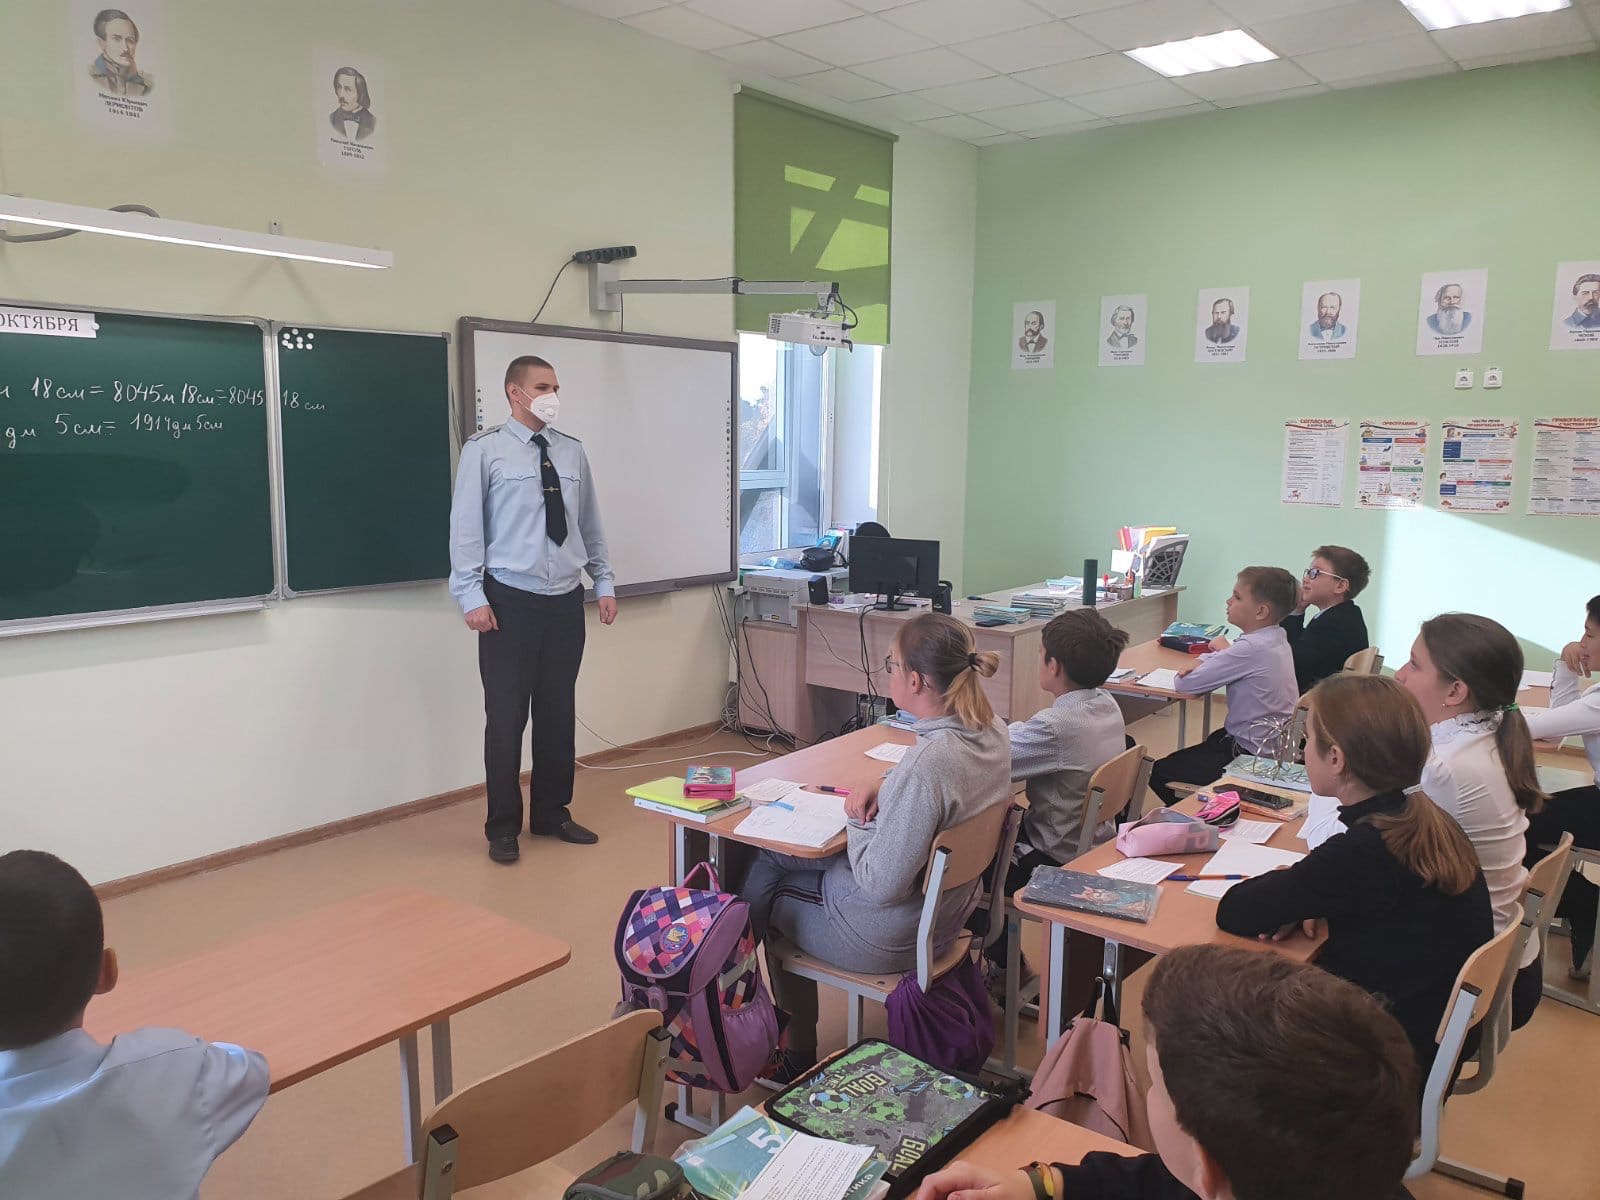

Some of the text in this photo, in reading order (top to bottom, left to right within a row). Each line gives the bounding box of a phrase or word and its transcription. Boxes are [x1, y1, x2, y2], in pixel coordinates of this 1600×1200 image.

[839, 1072, 888, 1097] GOAL
[746, 1127, 785, 1154] 5
[891, 1138, 927, 1172] GOAL
